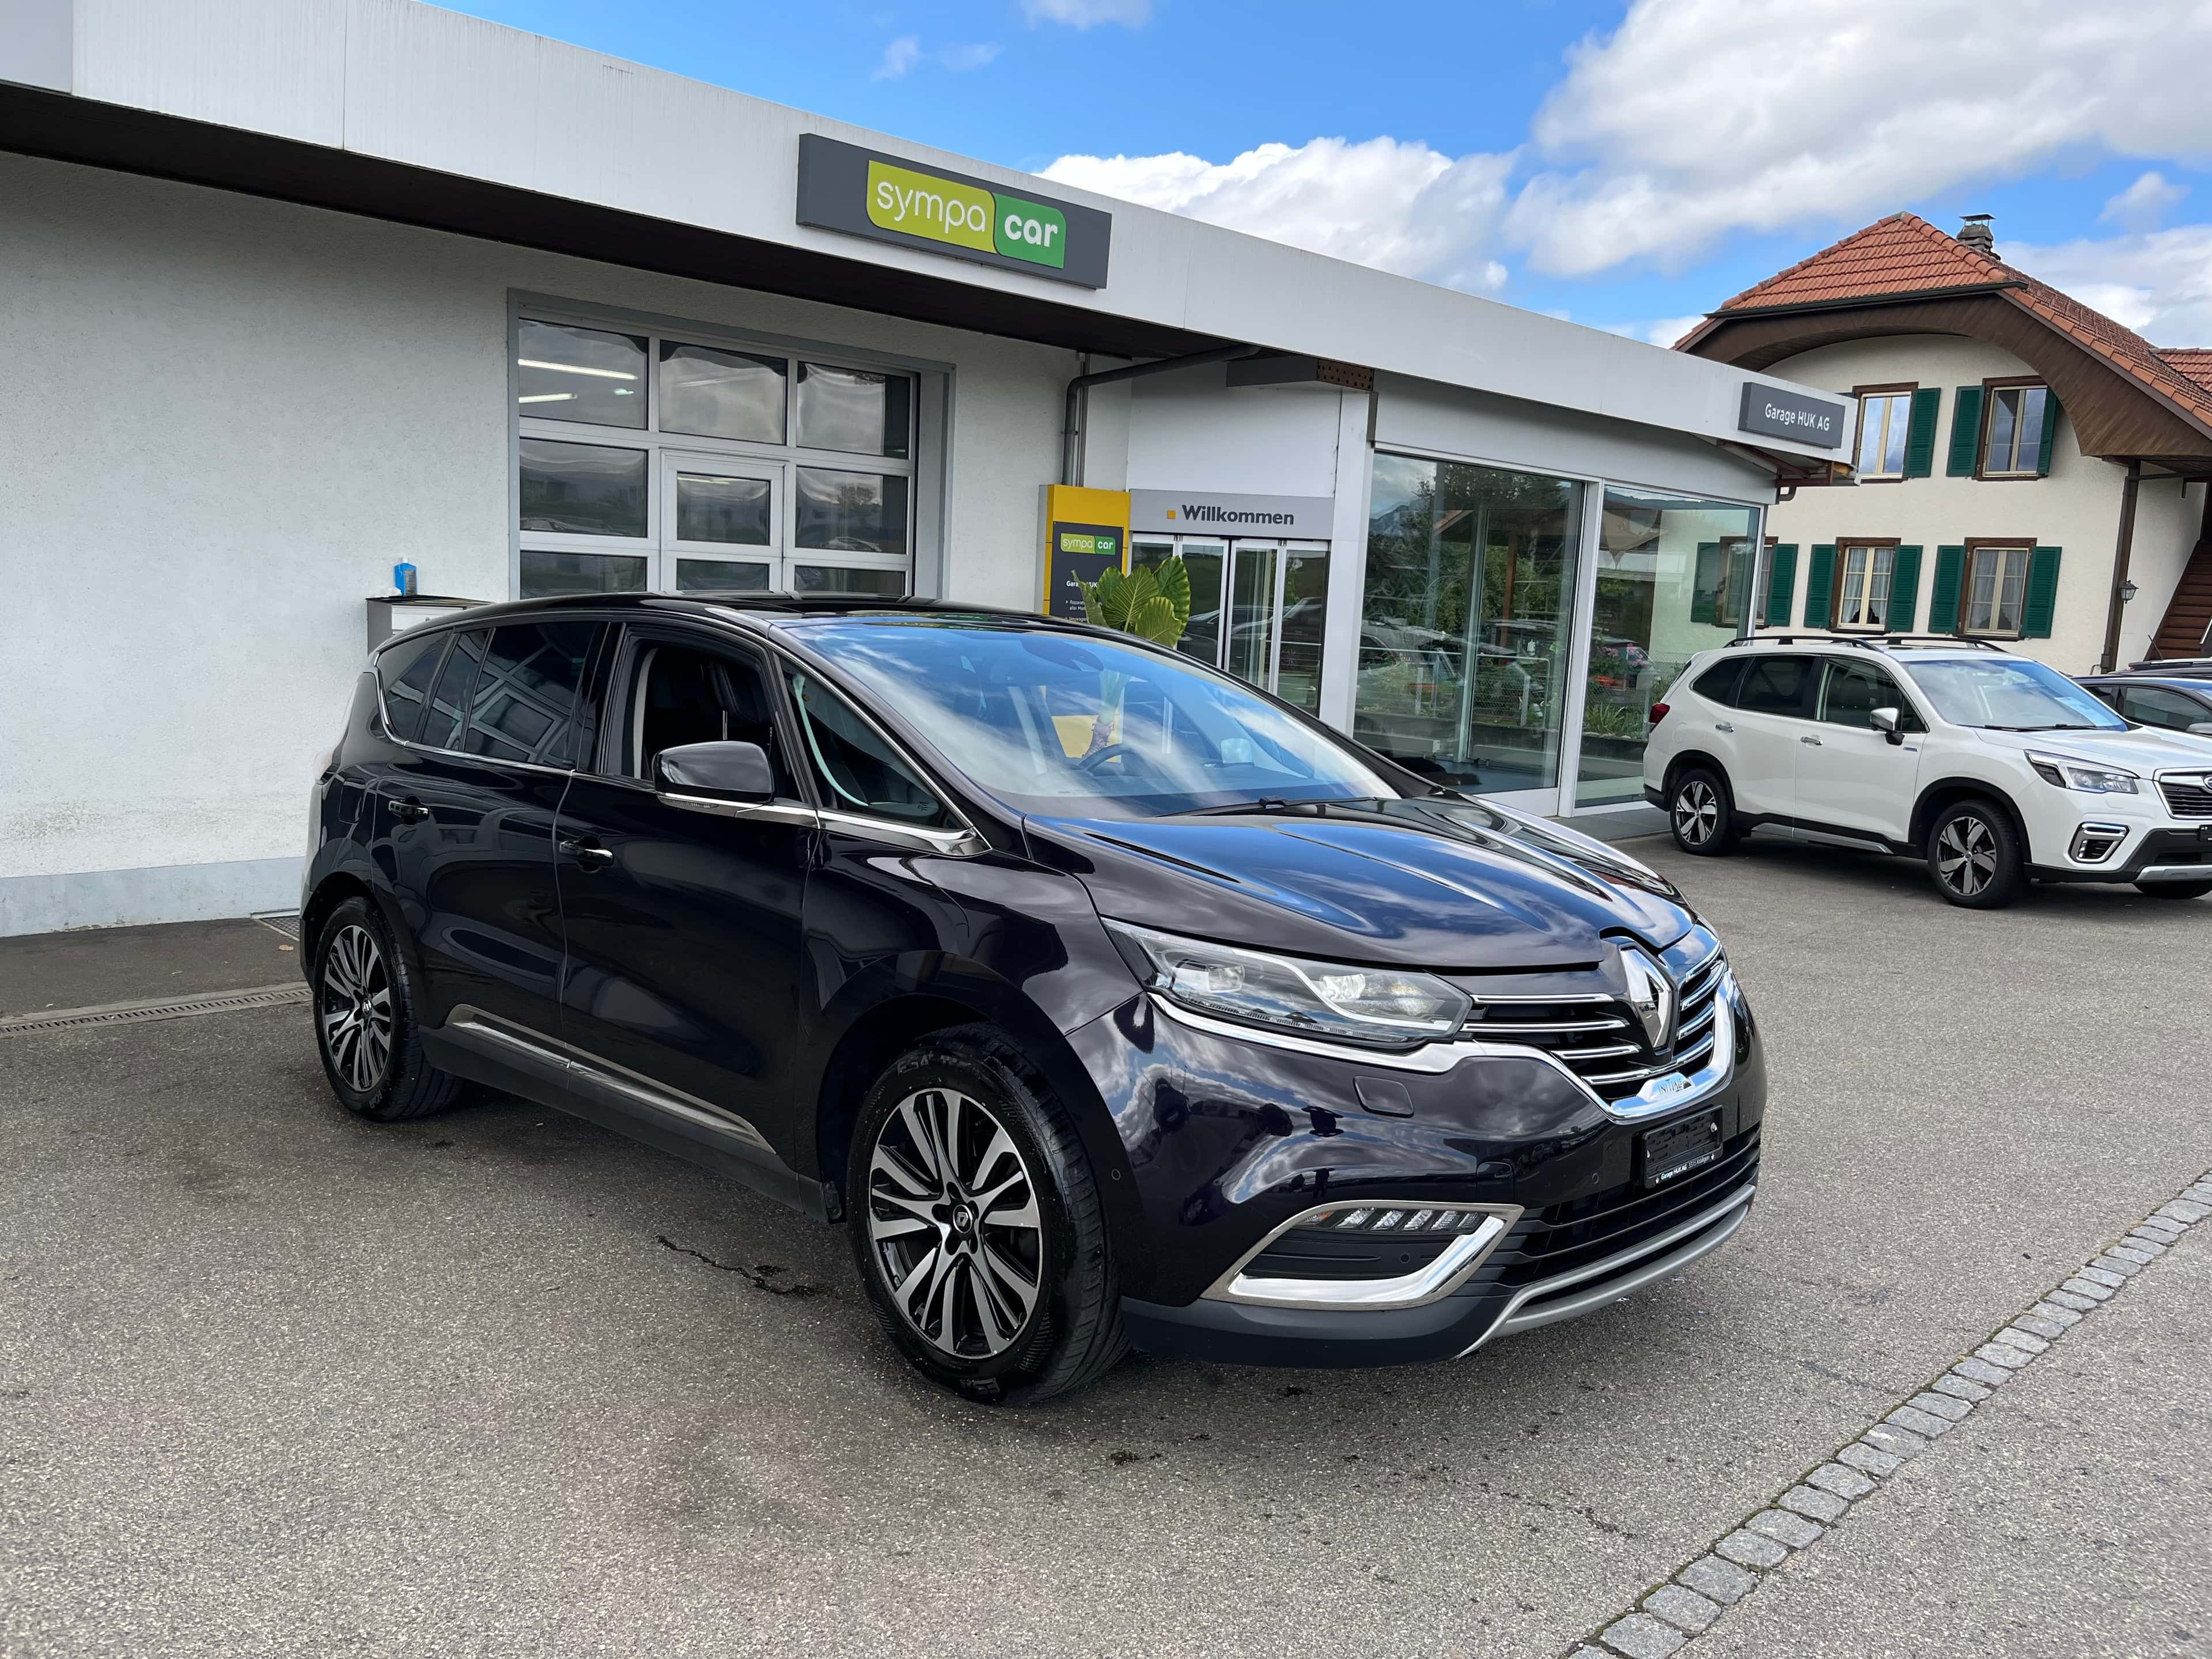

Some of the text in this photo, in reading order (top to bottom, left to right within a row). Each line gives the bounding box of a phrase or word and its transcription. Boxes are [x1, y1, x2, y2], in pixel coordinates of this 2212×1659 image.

[877, 181, 1058, 248] sympa car
[1764, 403, 1830, 431] Garage HUK AG
[1181, 504, 1294, 525] Willkommen
[1063, 538, 1113, 551] sympa car
